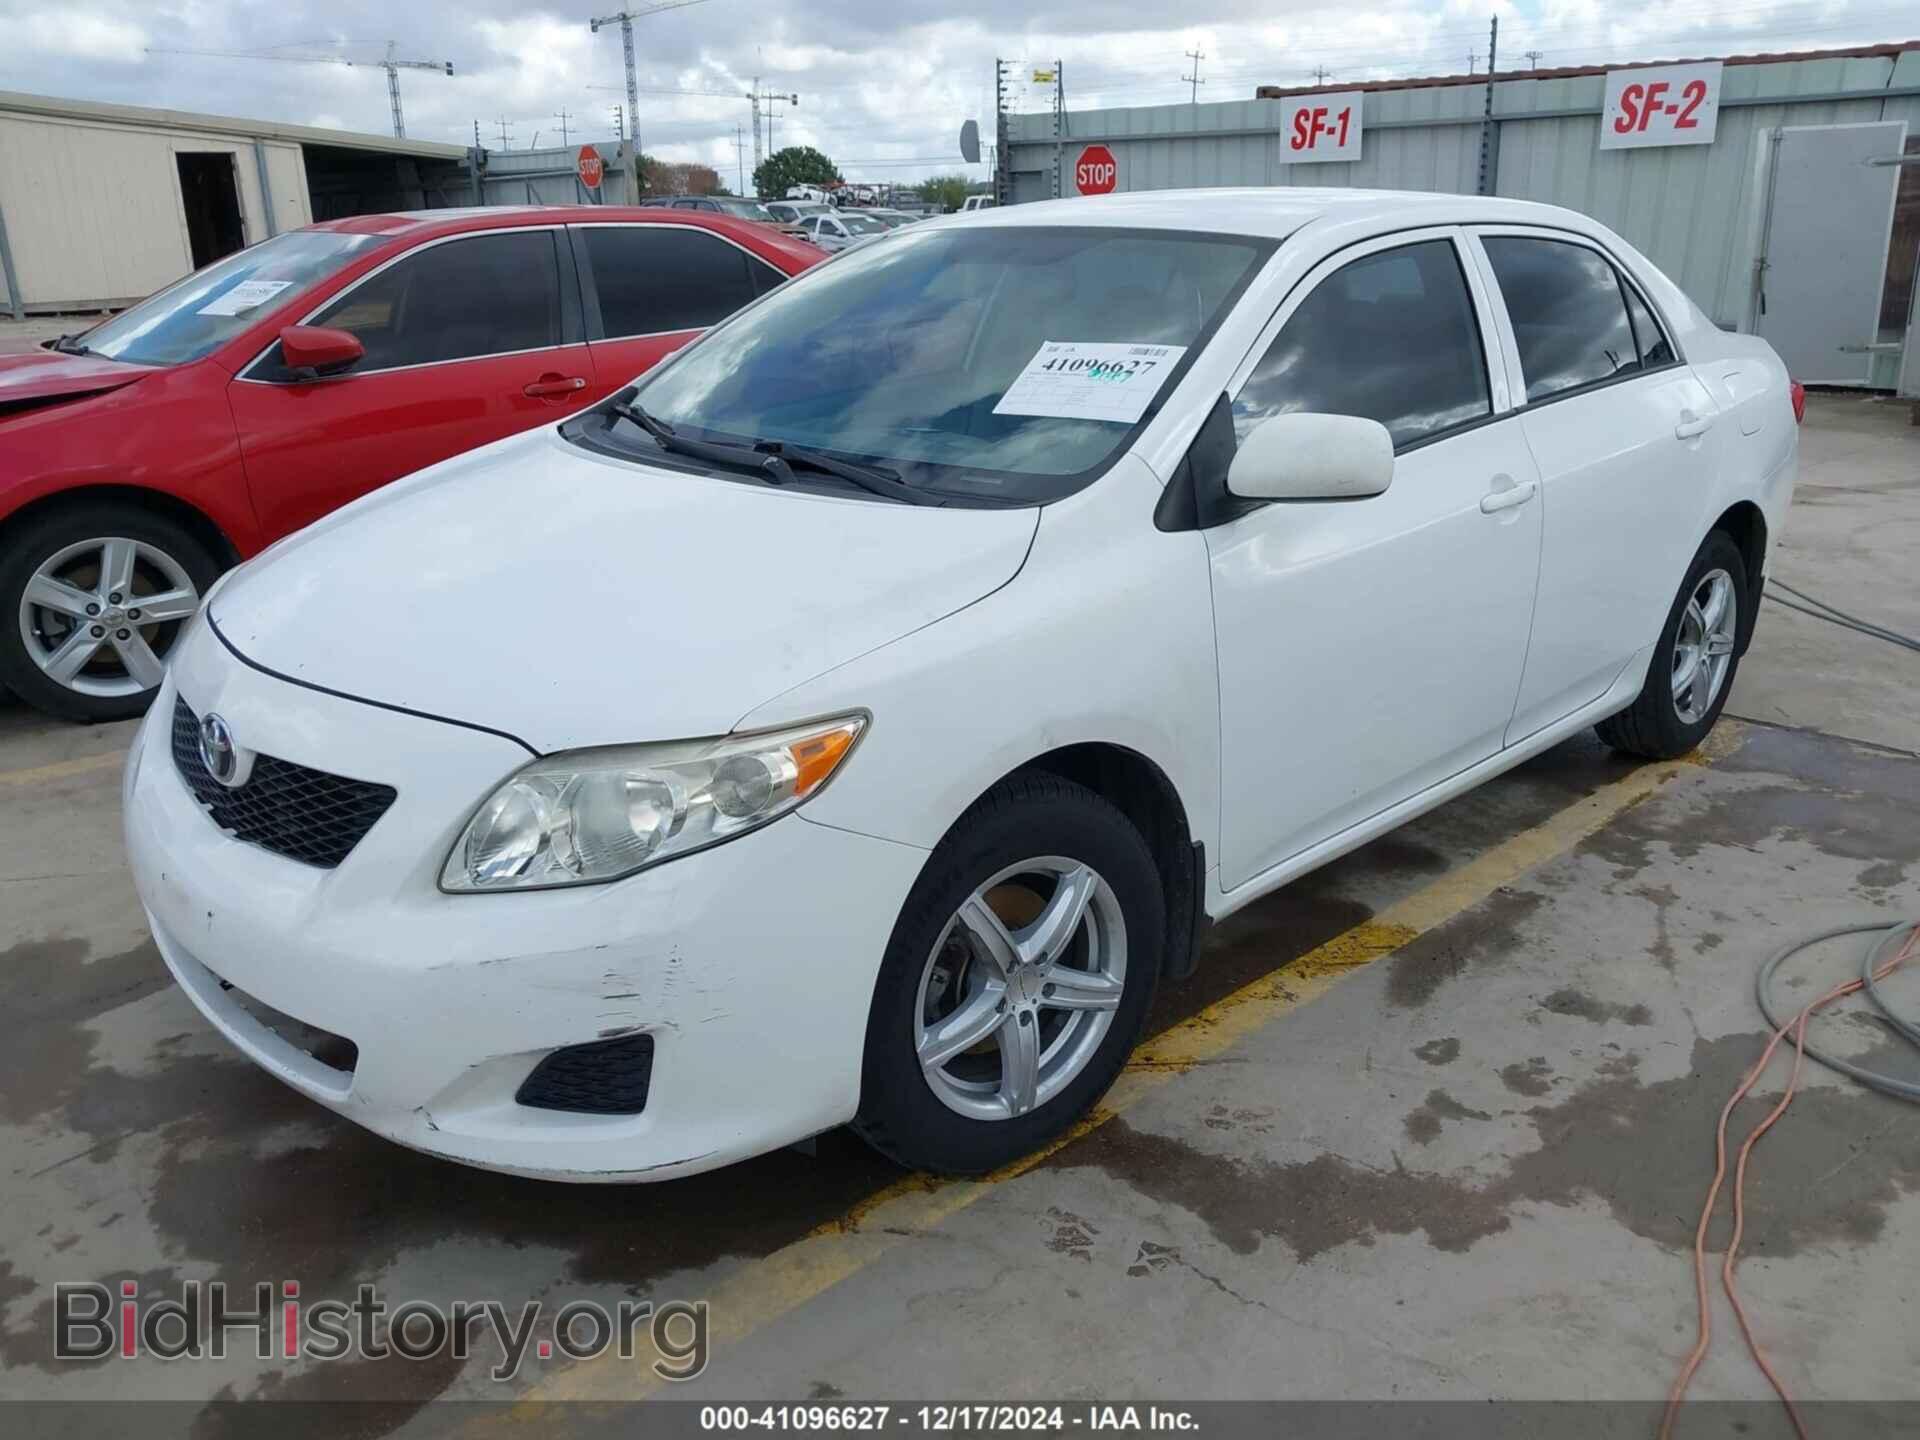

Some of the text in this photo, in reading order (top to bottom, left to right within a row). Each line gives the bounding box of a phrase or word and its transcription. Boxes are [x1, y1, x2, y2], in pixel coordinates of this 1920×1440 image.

[1614, 80, 1707, 134] SF-2
[1290, 107, 1351, 151] SF-1
[579, 158, 600, 175] STOP
[1078, 163, 1114, 185] STOP
[1042, 357, 1157, 375] 41096627
